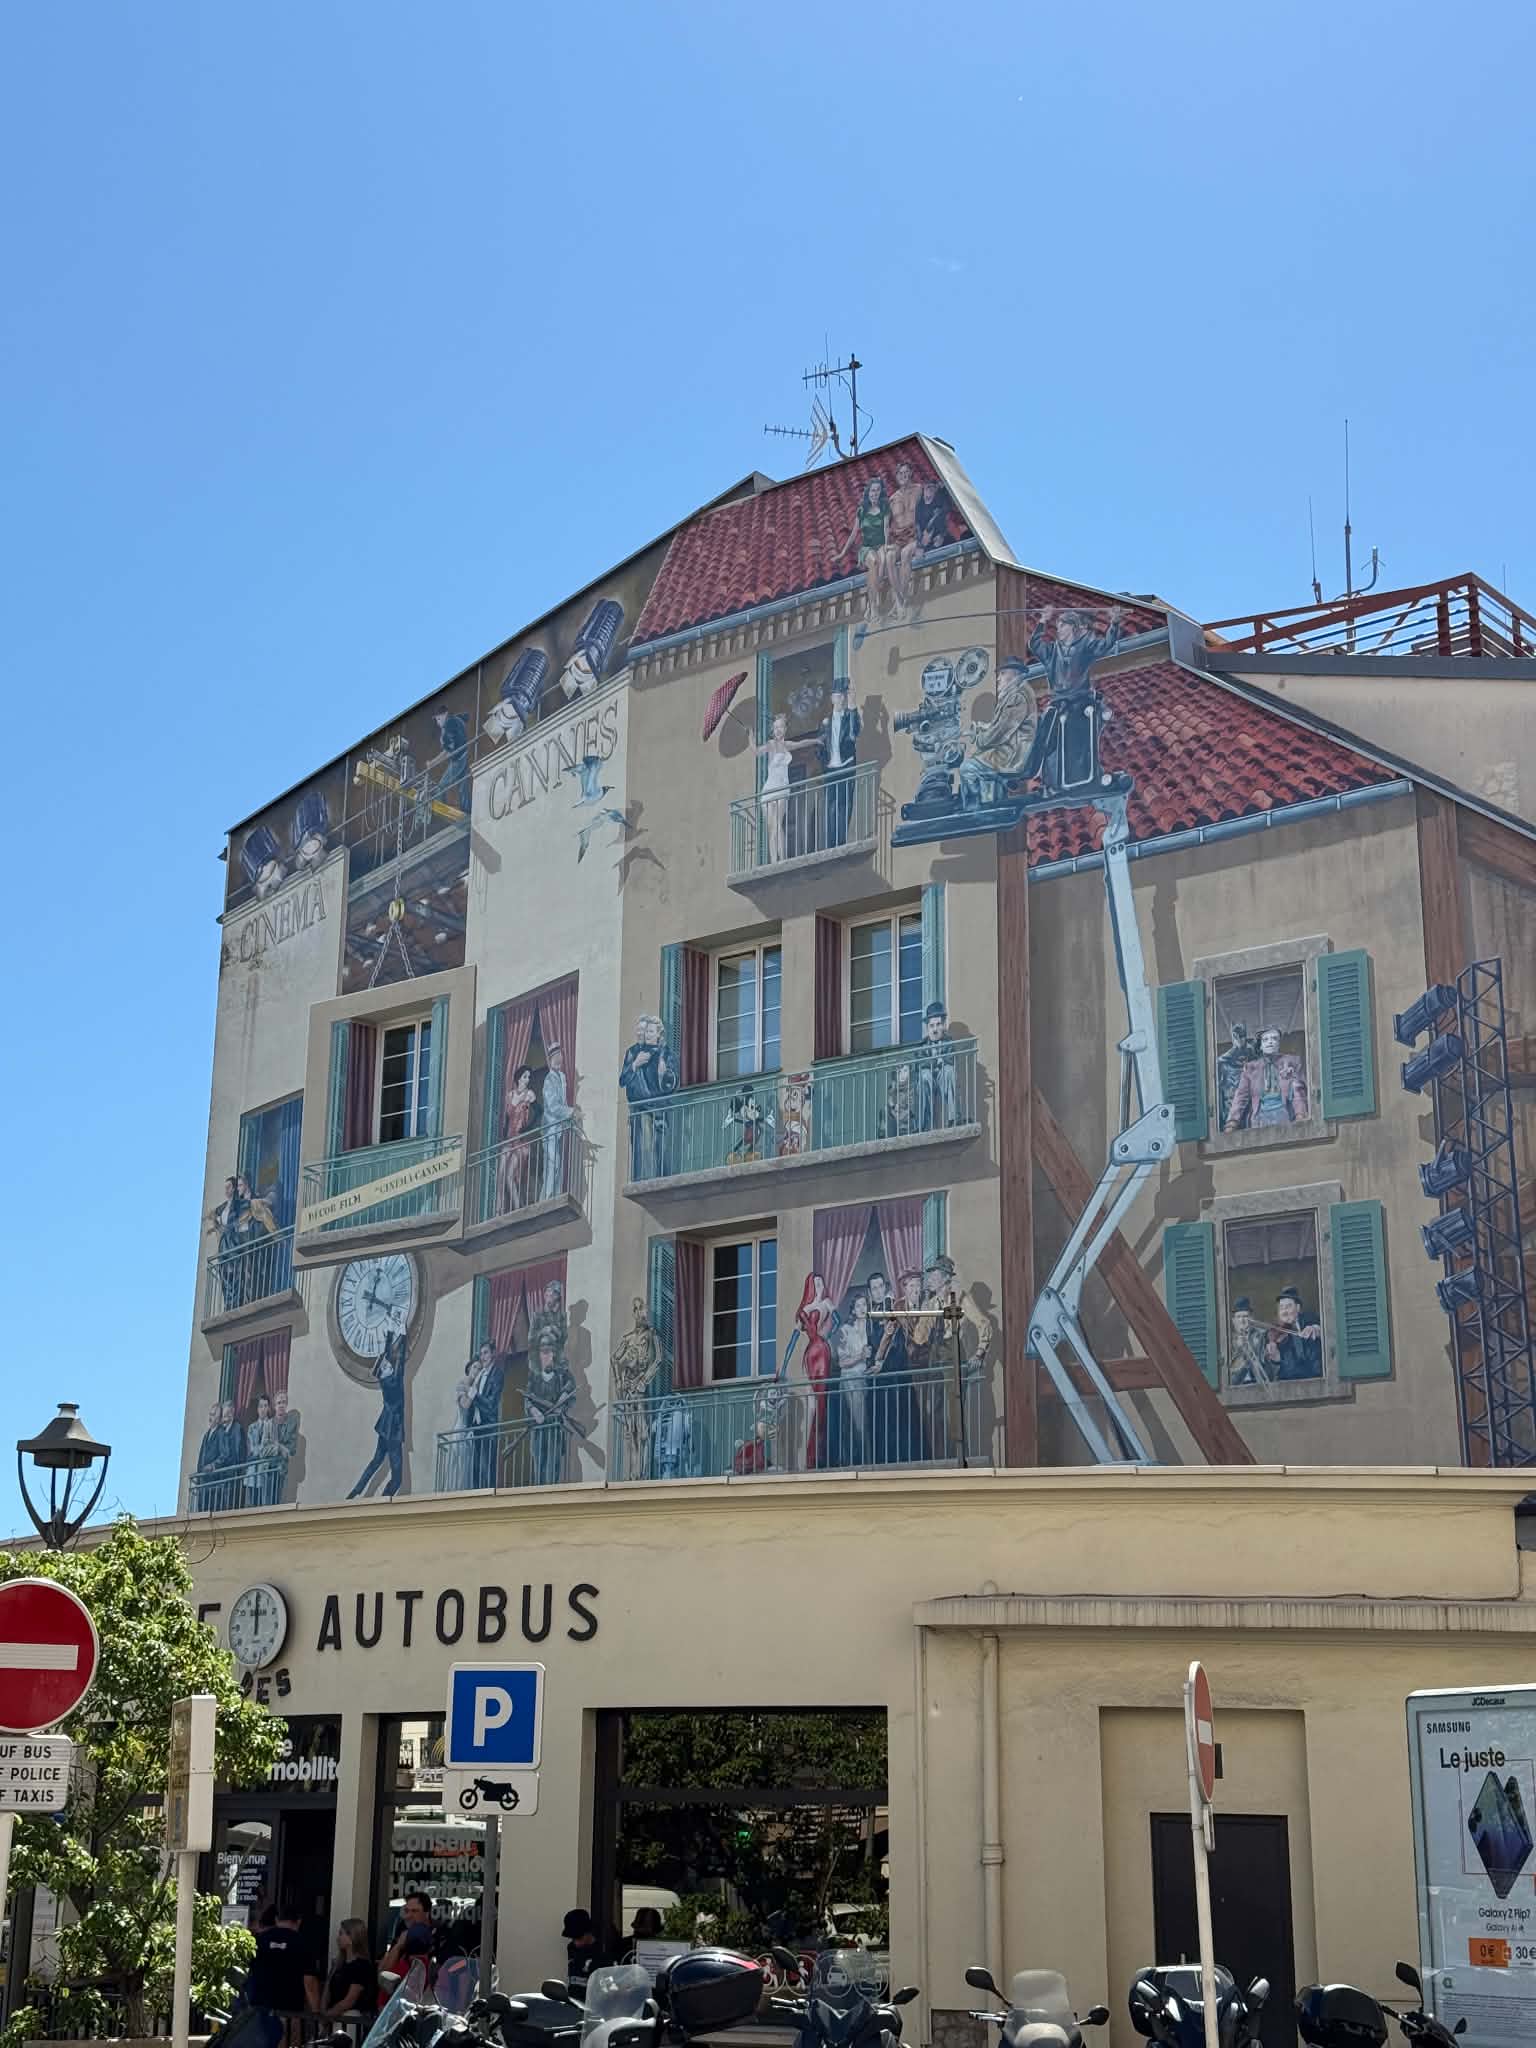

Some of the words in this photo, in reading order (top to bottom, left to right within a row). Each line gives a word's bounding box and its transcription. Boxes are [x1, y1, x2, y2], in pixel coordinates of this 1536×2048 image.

[488, 699, 619, 821] CANNES
[240, 877, 326, 963] CINEMA
[339, 1193, 361, 1209] FILM
[317, 1583, 599, 1650] AUTOBUS
[473, 1686, 513, 1746] P
[1427, 1721, 1471, 1734] SAMSUNG
[24, 1746, 52, 1758] BUS
[1440, 1747, 1461, 1768] Le
[1464, 1746, 1505, 1773] juste
[10, 1767, 61, 1780] POLICE
[266, 1756, 340, 1780] mobilit
[14, 1790, 54, 1802] TAXIS
[1479, 1907, 1507, 1920] Galaxy
[1513, 1908, 1531, 1920] Flip7
